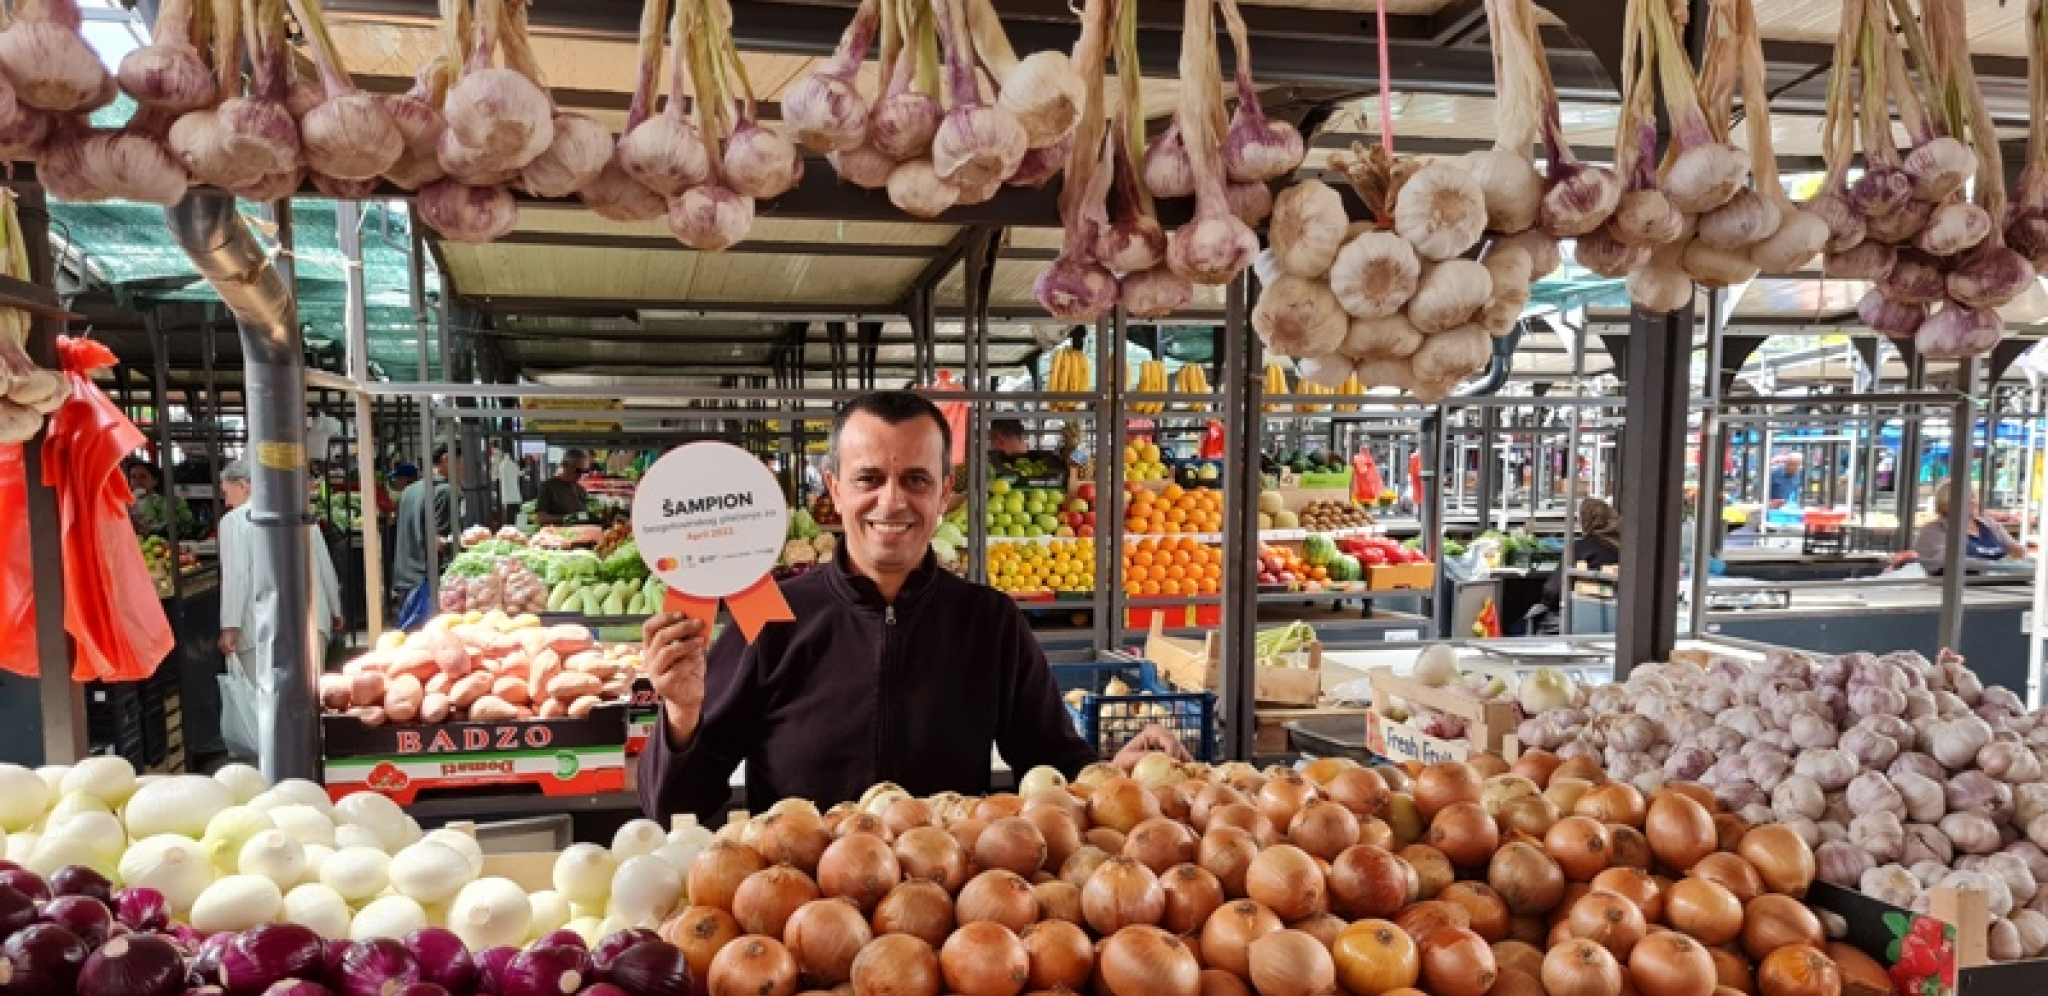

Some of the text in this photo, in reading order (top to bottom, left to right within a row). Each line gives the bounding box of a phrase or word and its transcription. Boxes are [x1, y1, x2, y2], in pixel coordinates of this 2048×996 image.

[663, 491, 753, 517] ŠAMPION
[686, 531, 710, 541] April
[397, 725, 553, 754] BADZO
[1387, 726, 1418, 758] Fresh
